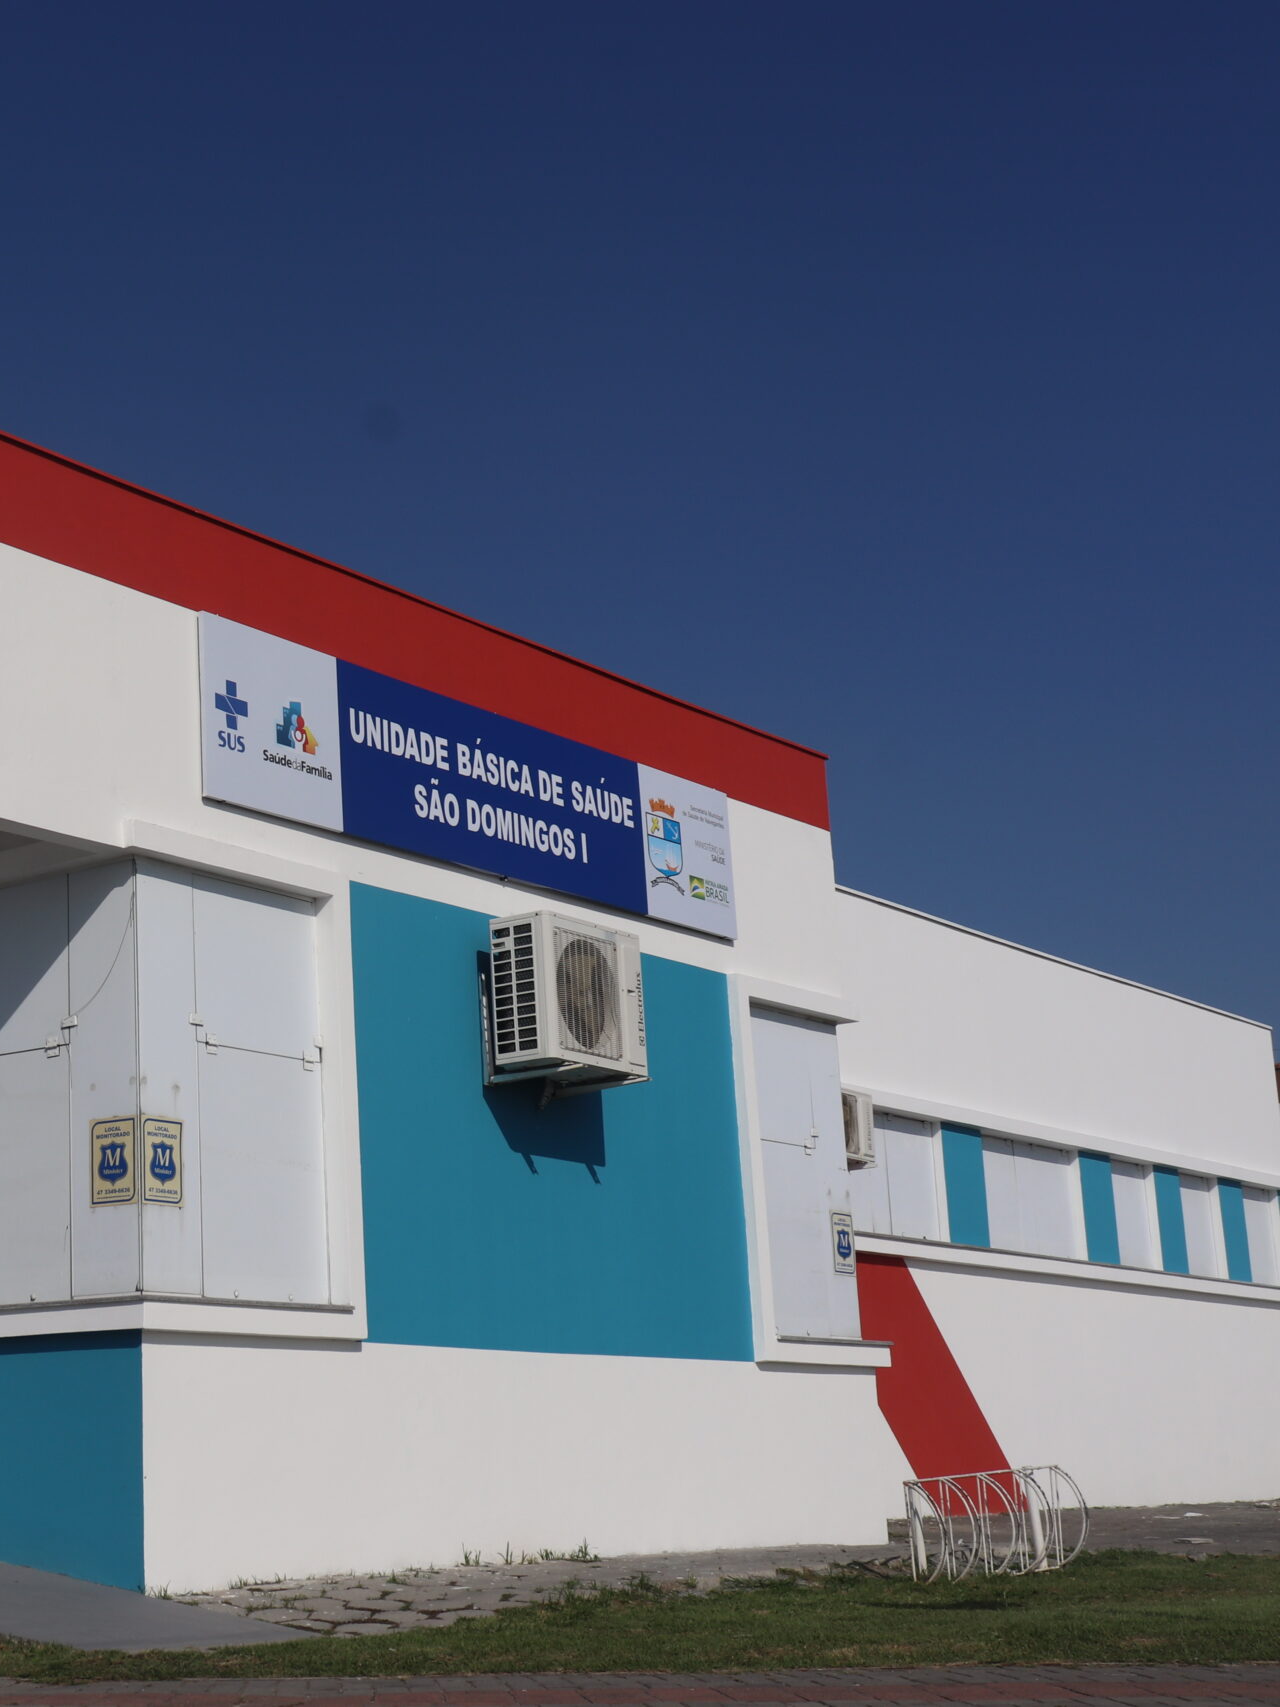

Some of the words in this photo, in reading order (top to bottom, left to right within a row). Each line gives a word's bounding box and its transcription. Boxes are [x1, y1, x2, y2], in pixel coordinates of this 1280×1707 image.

[217, 730, 246, 753] SUS
[349, 707, 449, 771] UNIDADE
[457, 738, 534, 797] BÁSICA
[538, 770, 565, 807] DE
[571, 776, 635, 829] SAÚDE
[414, 778, 460, 827] SÃO
[466, 798, 576, 861] DOMINGOS
[581, 832, 588, 865] I
[705, 886, 730, 904] BRASIL
[96, 1131, 131, 1140] MONITORADO
[147, 1131, 178, 1140] MONITORADO
[154, 1125, 169, 1133] LOCAL
[104, 1147, 121, 1167] M
[156, 1147, 170, 1167] M
